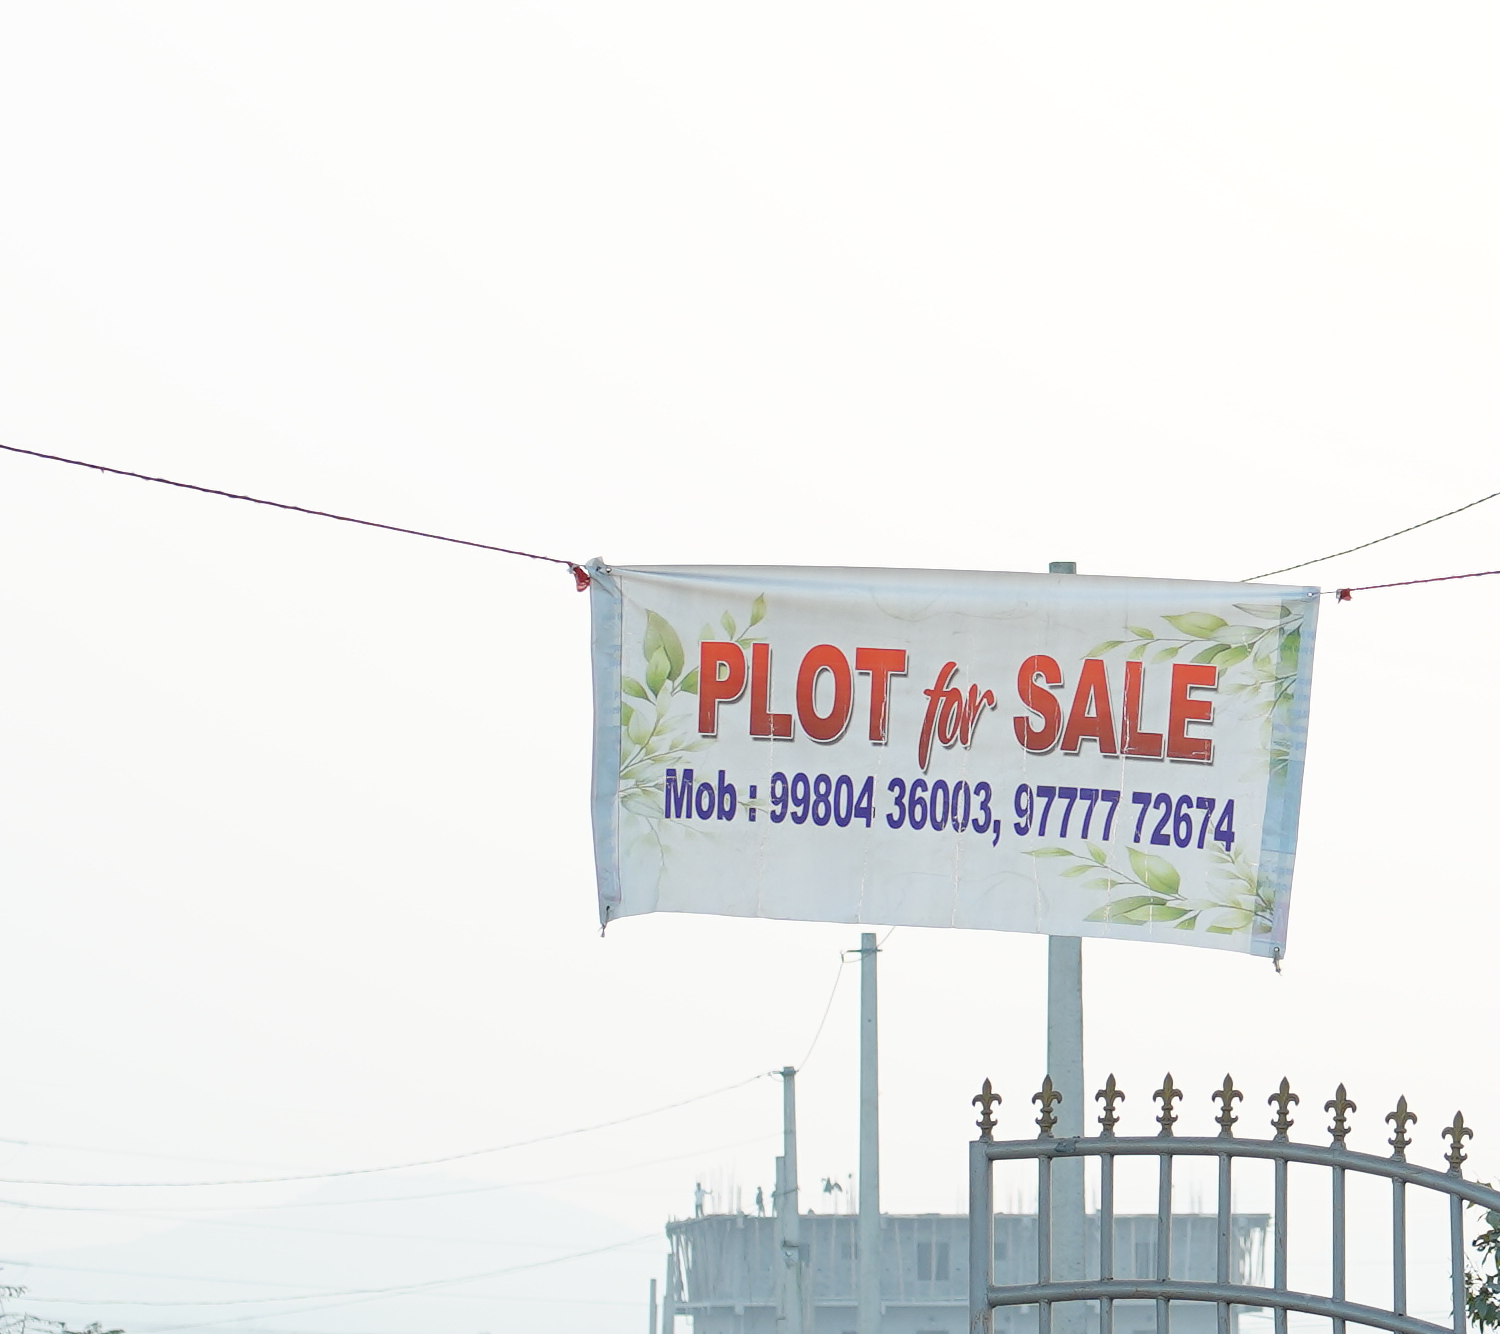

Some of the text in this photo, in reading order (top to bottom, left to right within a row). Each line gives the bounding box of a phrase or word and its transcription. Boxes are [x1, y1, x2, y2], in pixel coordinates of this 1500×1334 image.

[699, 642, 908, 744] PLOT
[918, 661, 996, 770] for
[1013, 654, 1220, 764] SALE
[664, 768, 737, 822] Mob
[770, 771, 876, 828] 99804
[886, 777, 1001, 847] 36003,
[1013, 783, 1122, 842] 97777
[1131, 791, 1236, 853] 72674
